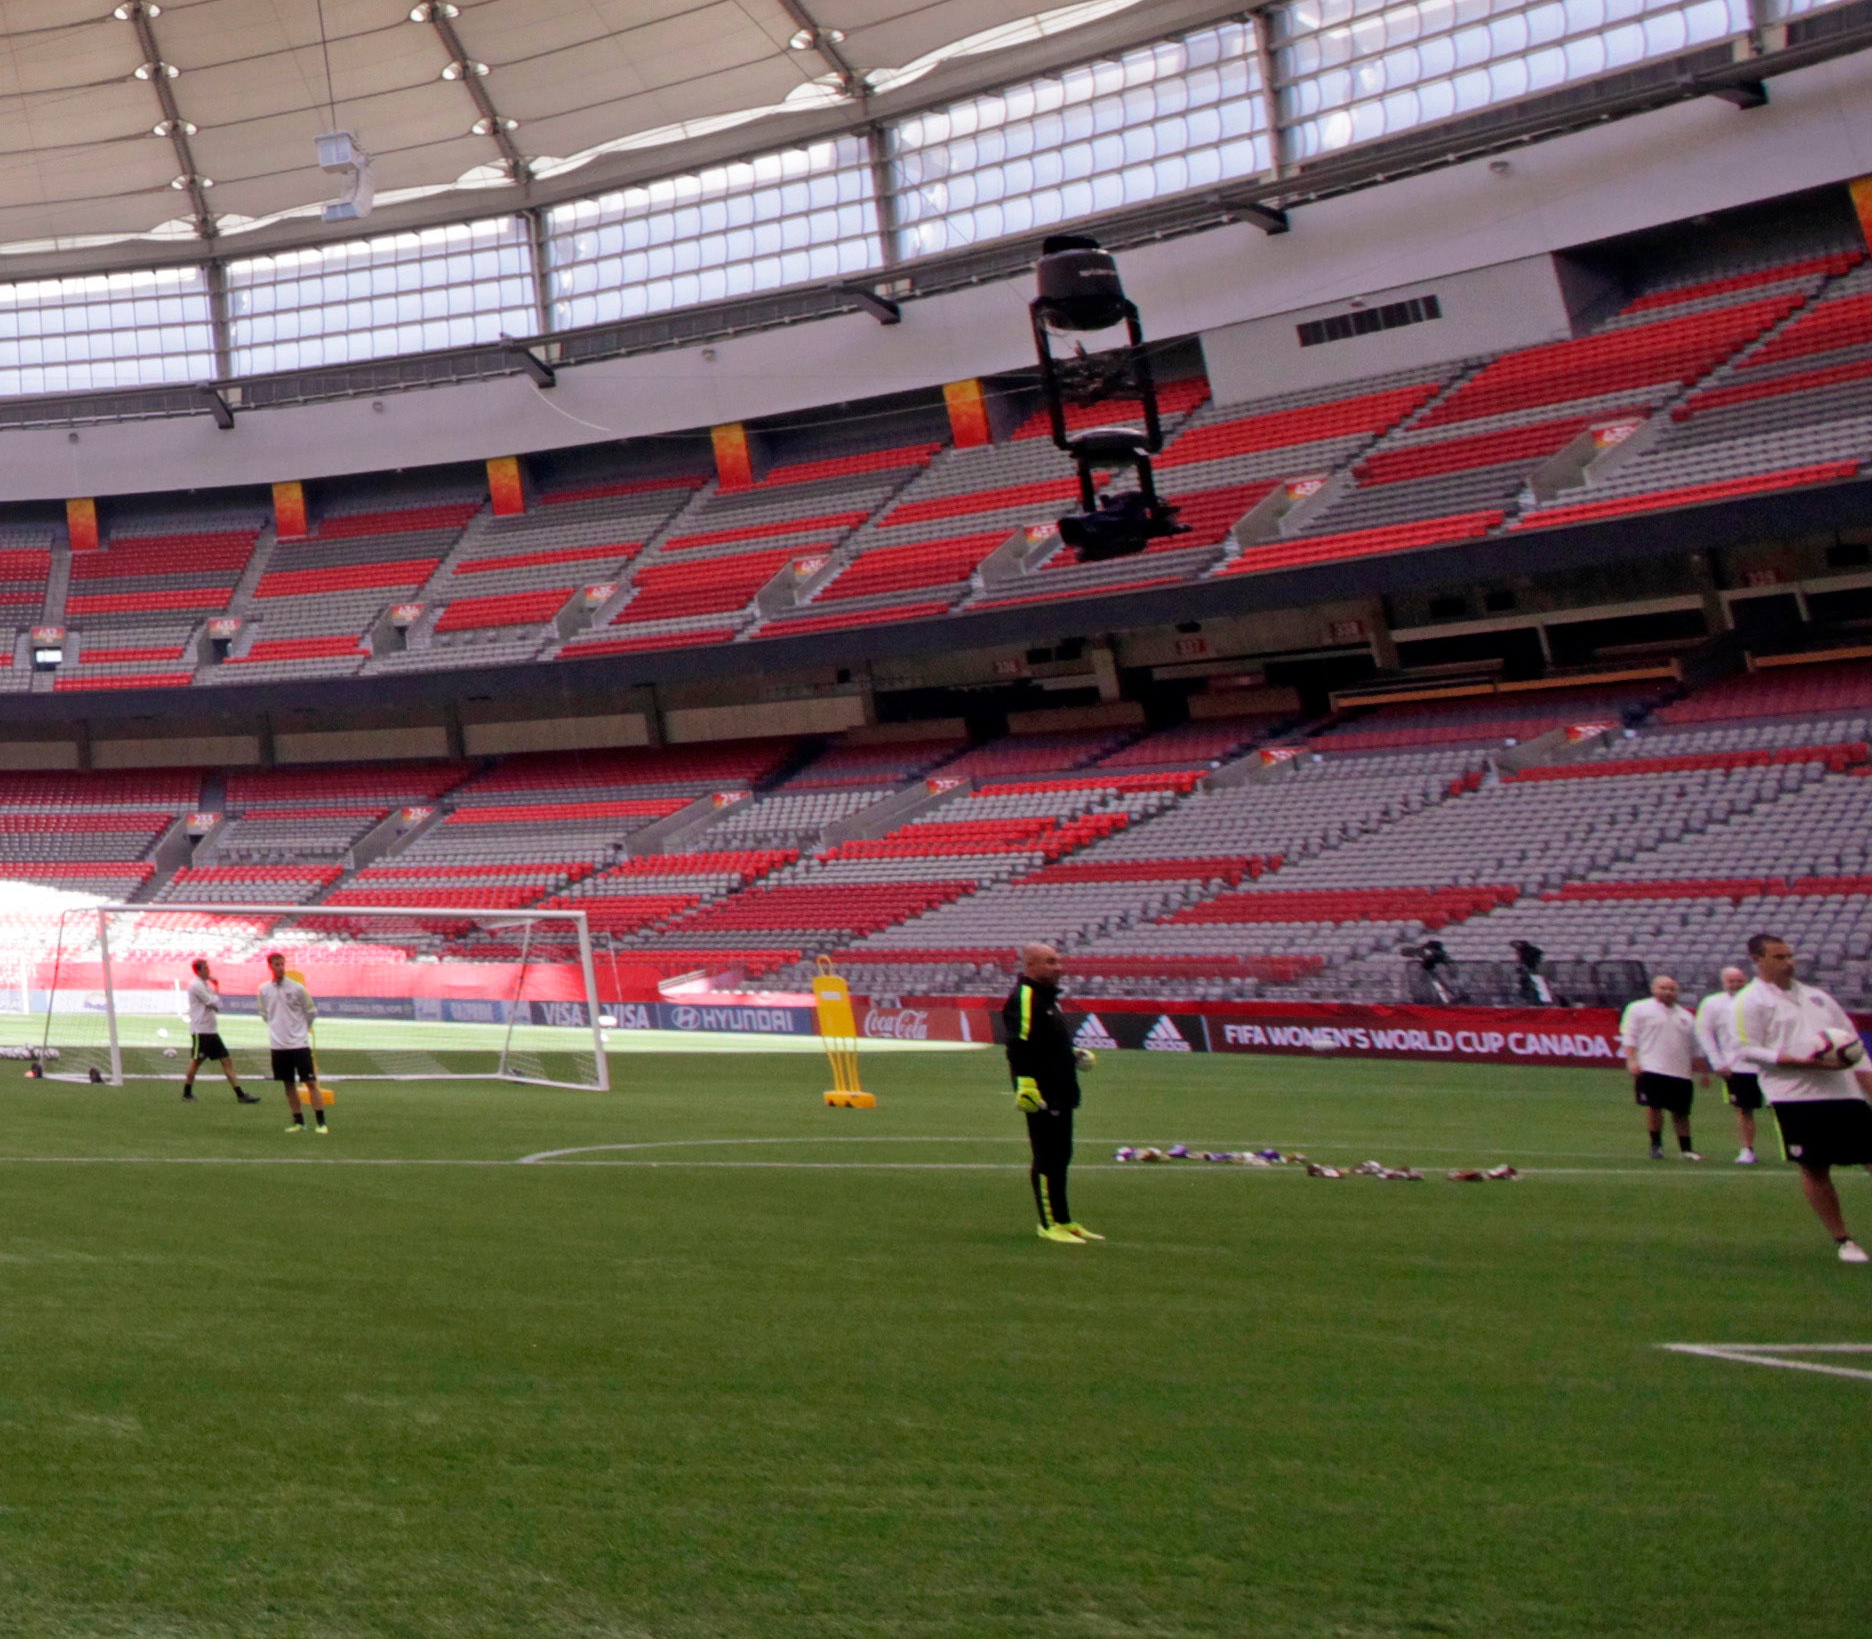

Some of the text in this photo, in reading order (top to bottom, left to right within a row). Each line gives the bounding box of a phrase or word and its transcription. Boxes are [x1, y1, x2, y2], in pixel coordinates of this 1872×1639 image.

[541, 1003, 584, 1026] VISA
[602, 1004, 650, 1029] VISA
[703, 1009, 793, 1032] HYUNDAI
[1073, 1036, 1118, 1049] adidas
[1143, 1039, 1192, 1052] adidas
[1224, 1024, 1267, 1045] FIFA
[1268, 1025, 1370, 1050] WOMEN'S
[1370, 1029, 1453, 1052] WORLD
[1456, 1030, 1505, 1053] CUP
[1508, 1032, 1613, 1058] CANADA
